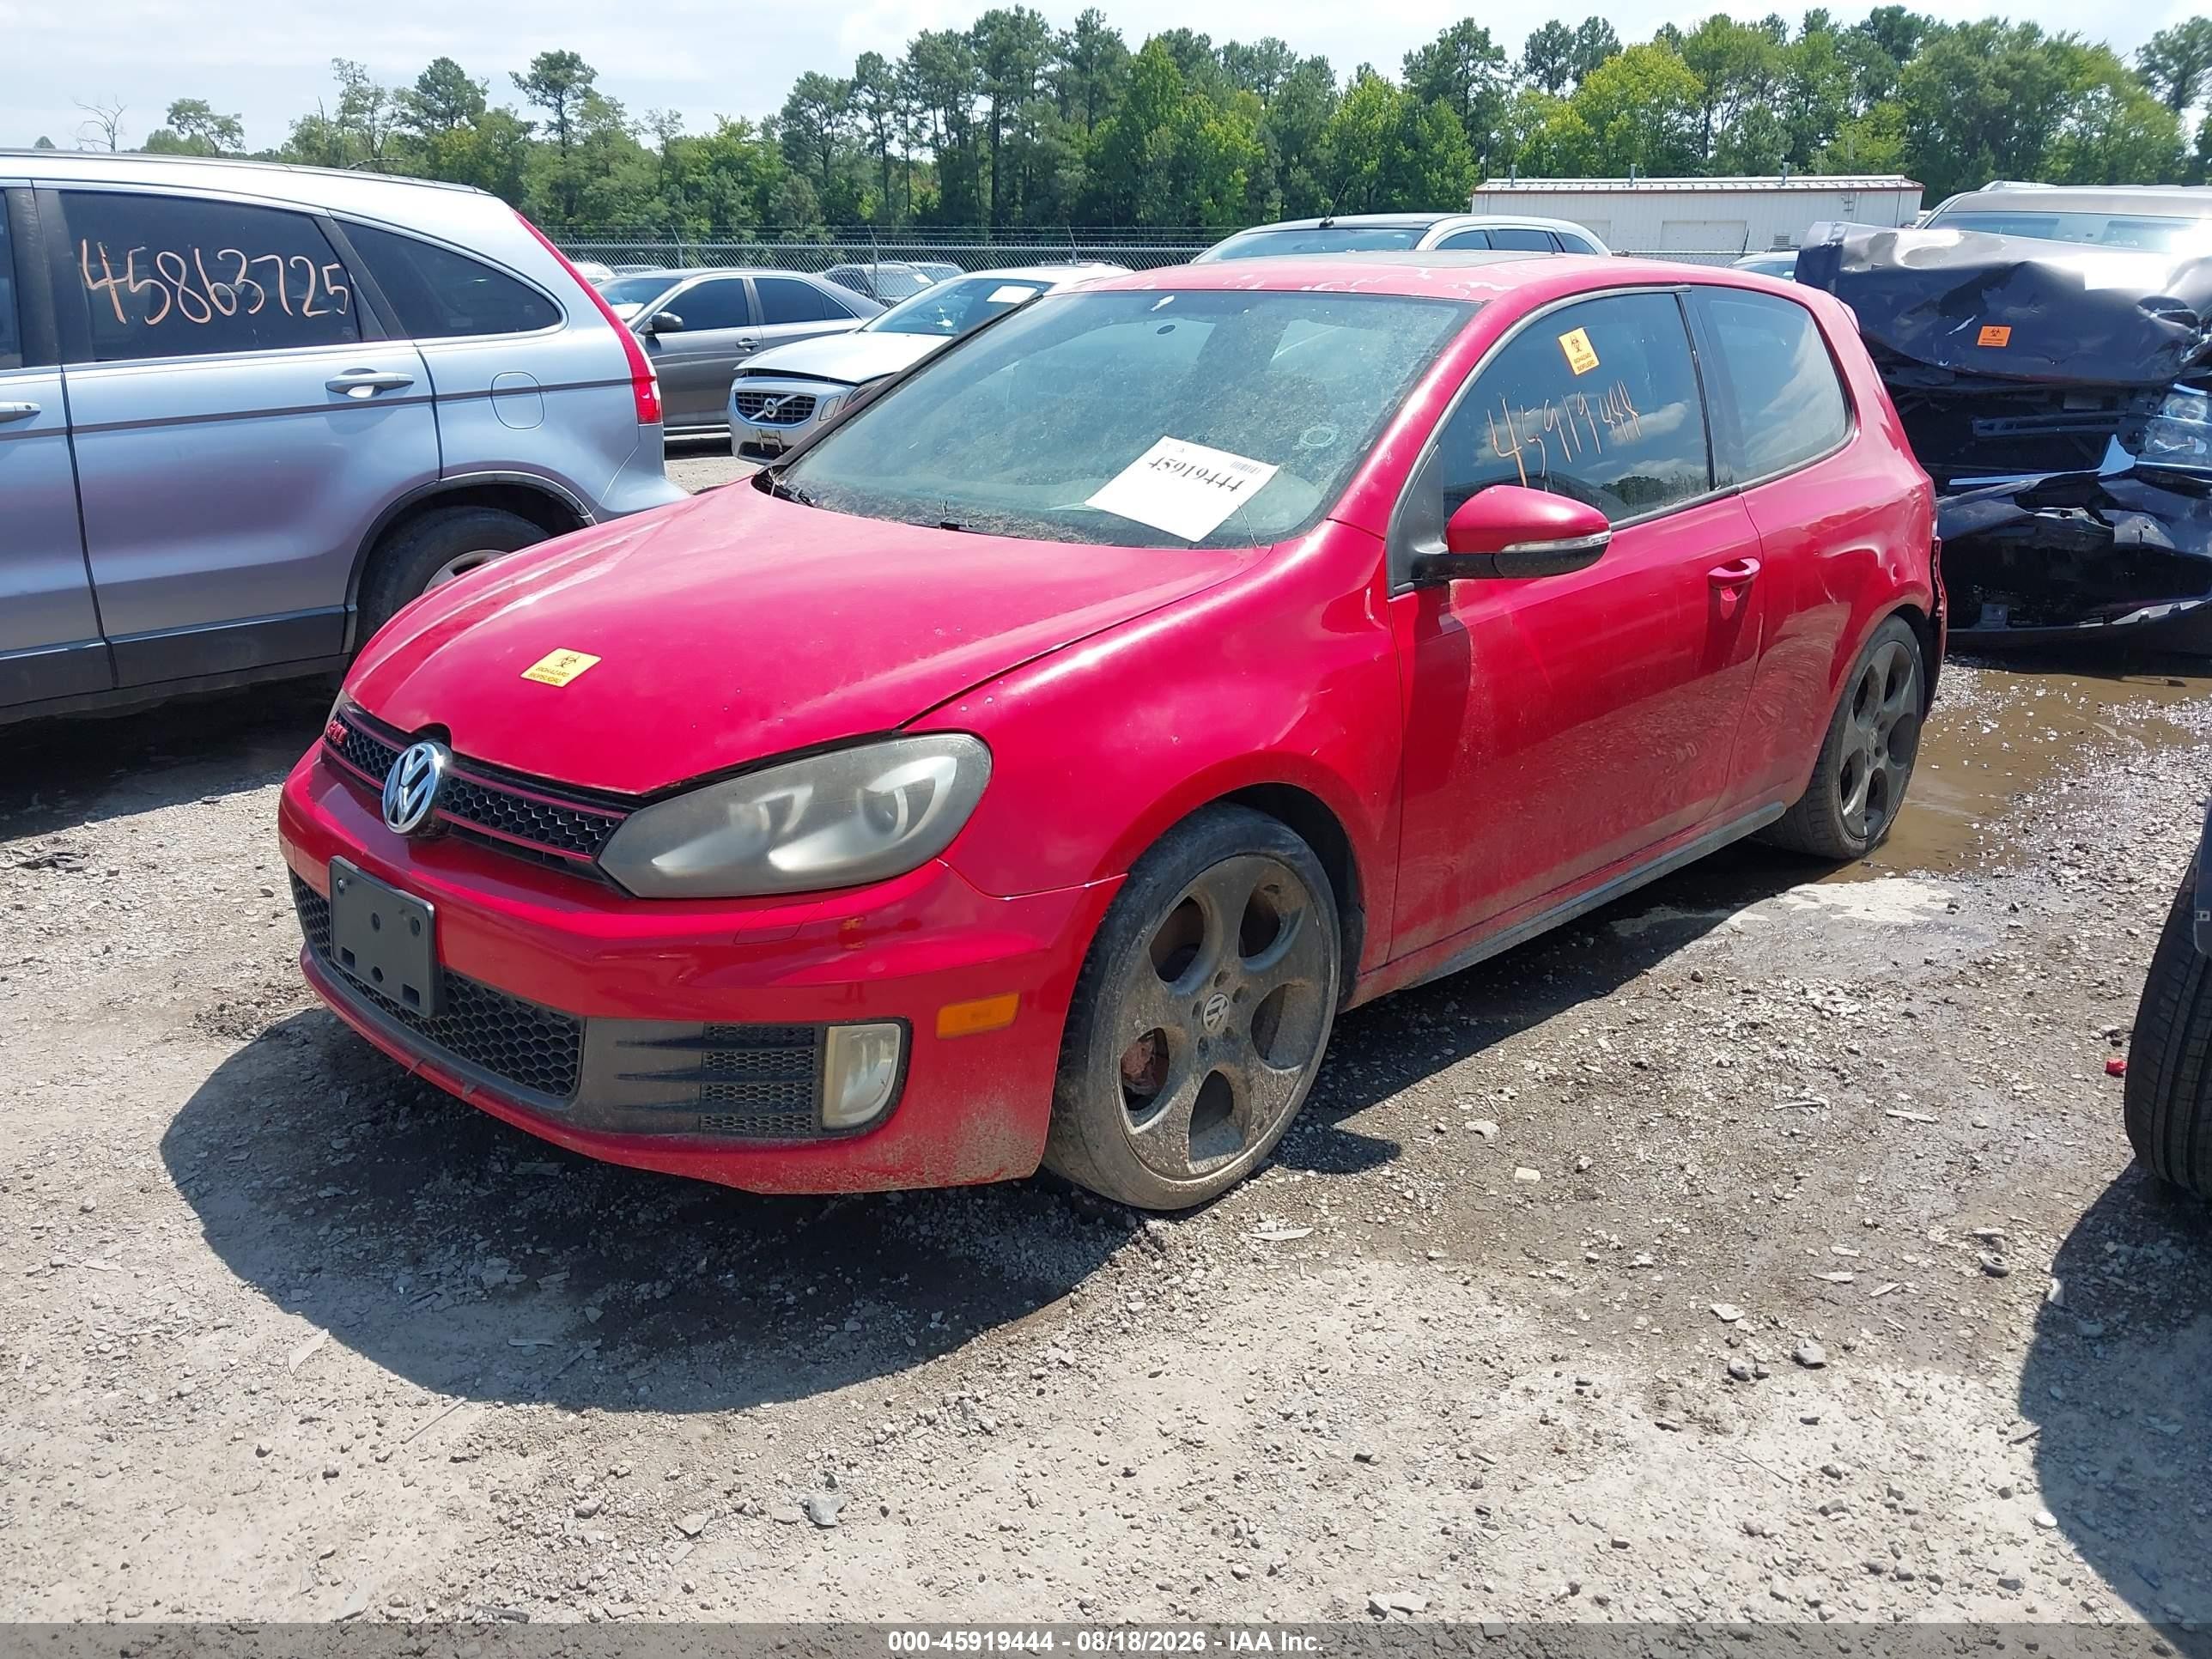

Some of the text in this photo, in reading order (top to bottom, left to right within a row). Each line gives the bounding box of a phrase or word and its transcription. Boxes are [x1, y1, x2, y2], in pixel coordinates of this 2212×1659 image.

[82, 239, 349, 325] 45863725
[1148, 456, 1245, 492] 45919444
[1487, 380, 1642, 488] 45919444
